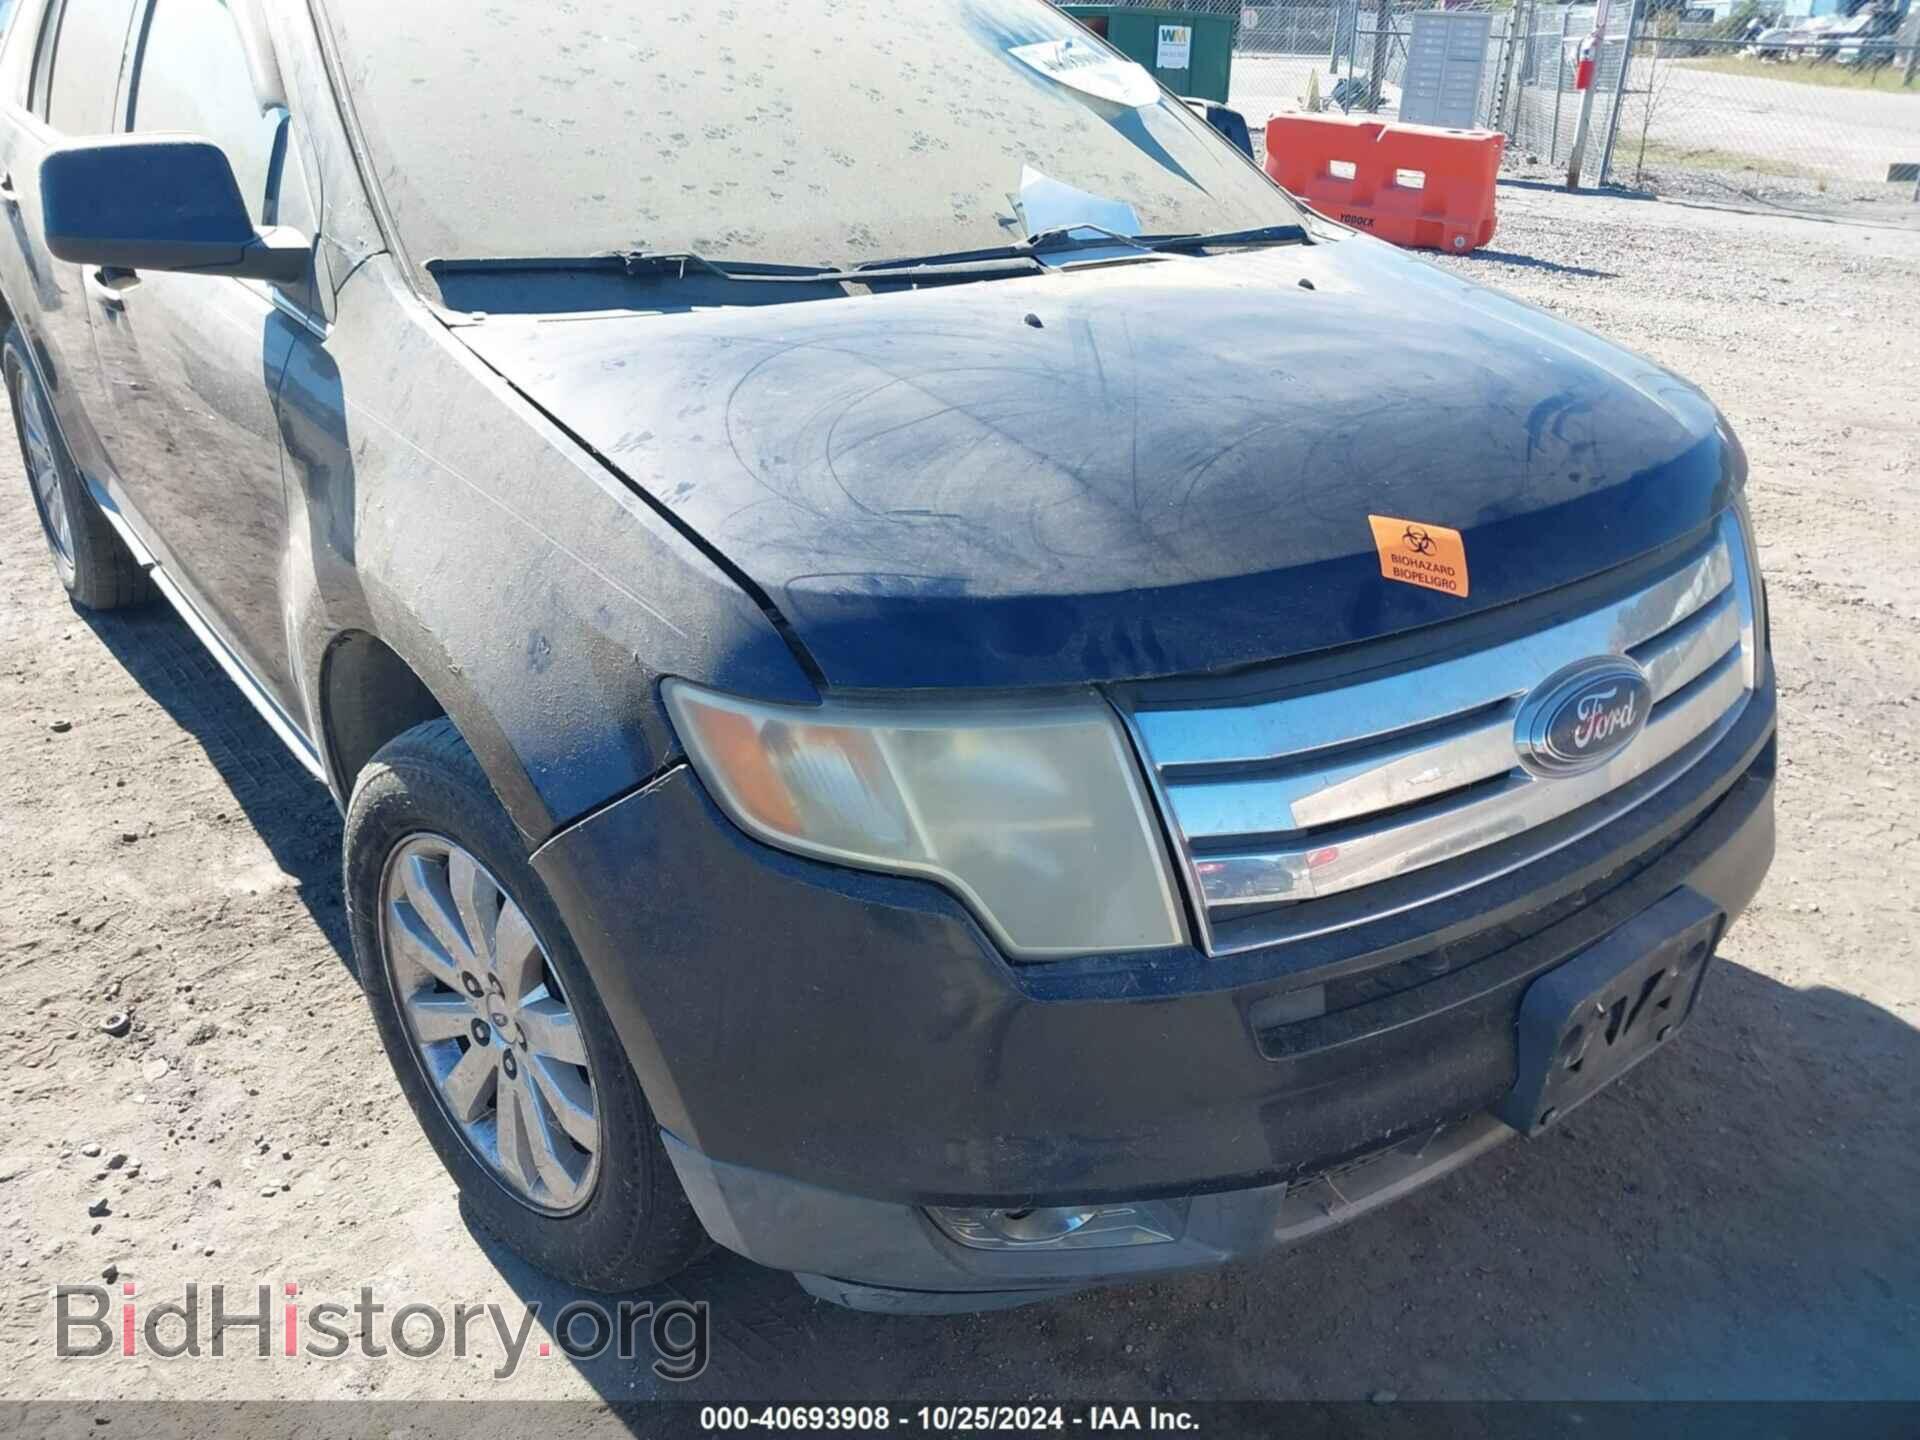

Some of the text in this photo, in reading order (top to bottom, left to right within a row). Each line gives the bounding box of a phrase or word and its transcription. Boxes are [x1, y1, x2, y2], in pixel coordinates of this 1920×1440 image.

[1161, 29, 1187, 42] WM
[1391, 554, 1455, 577] BIOHAZARD
[1392, 567, 1457, 591] BIOPELIGRO
[1574, 686, 1636, 748] Ford
